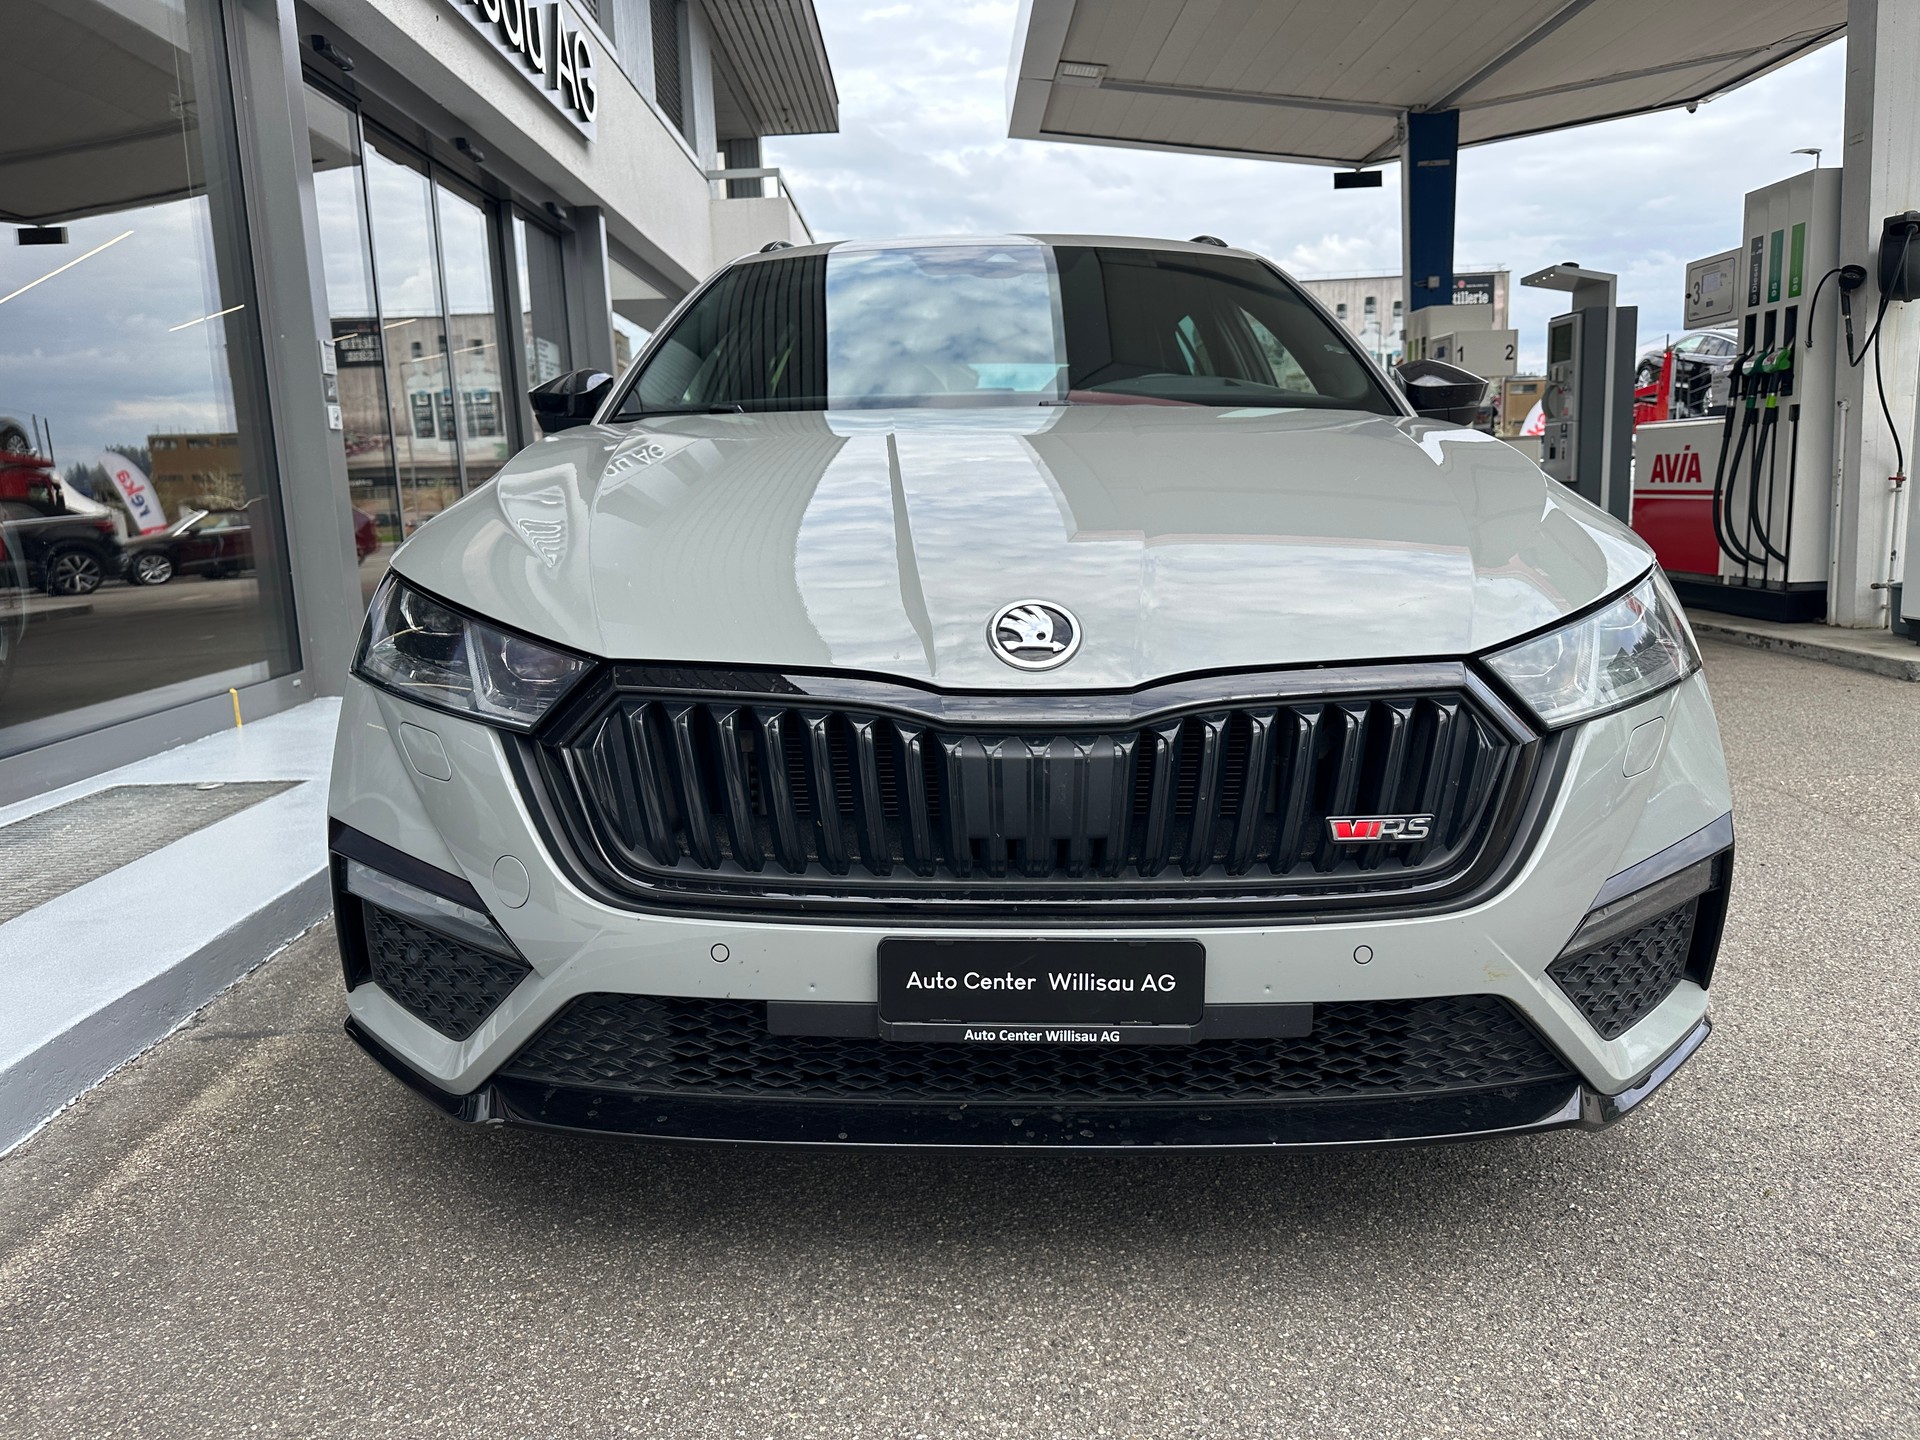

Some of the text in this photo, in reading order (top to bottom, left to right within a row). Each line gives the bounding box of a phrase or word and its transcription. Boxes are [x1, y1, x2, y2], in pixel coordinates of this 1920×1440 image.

[557, 3, 598, 123] AG
[1693, 282, 1701, 306] 3
[1457, 346, 1464, 362] 1
[1505, 345, 1514, 360] 2
[906, 971, 1176, 992] Auto Center Willisau AG
[964, 1029, 1120, 1043] Auto Center Willisau AG
